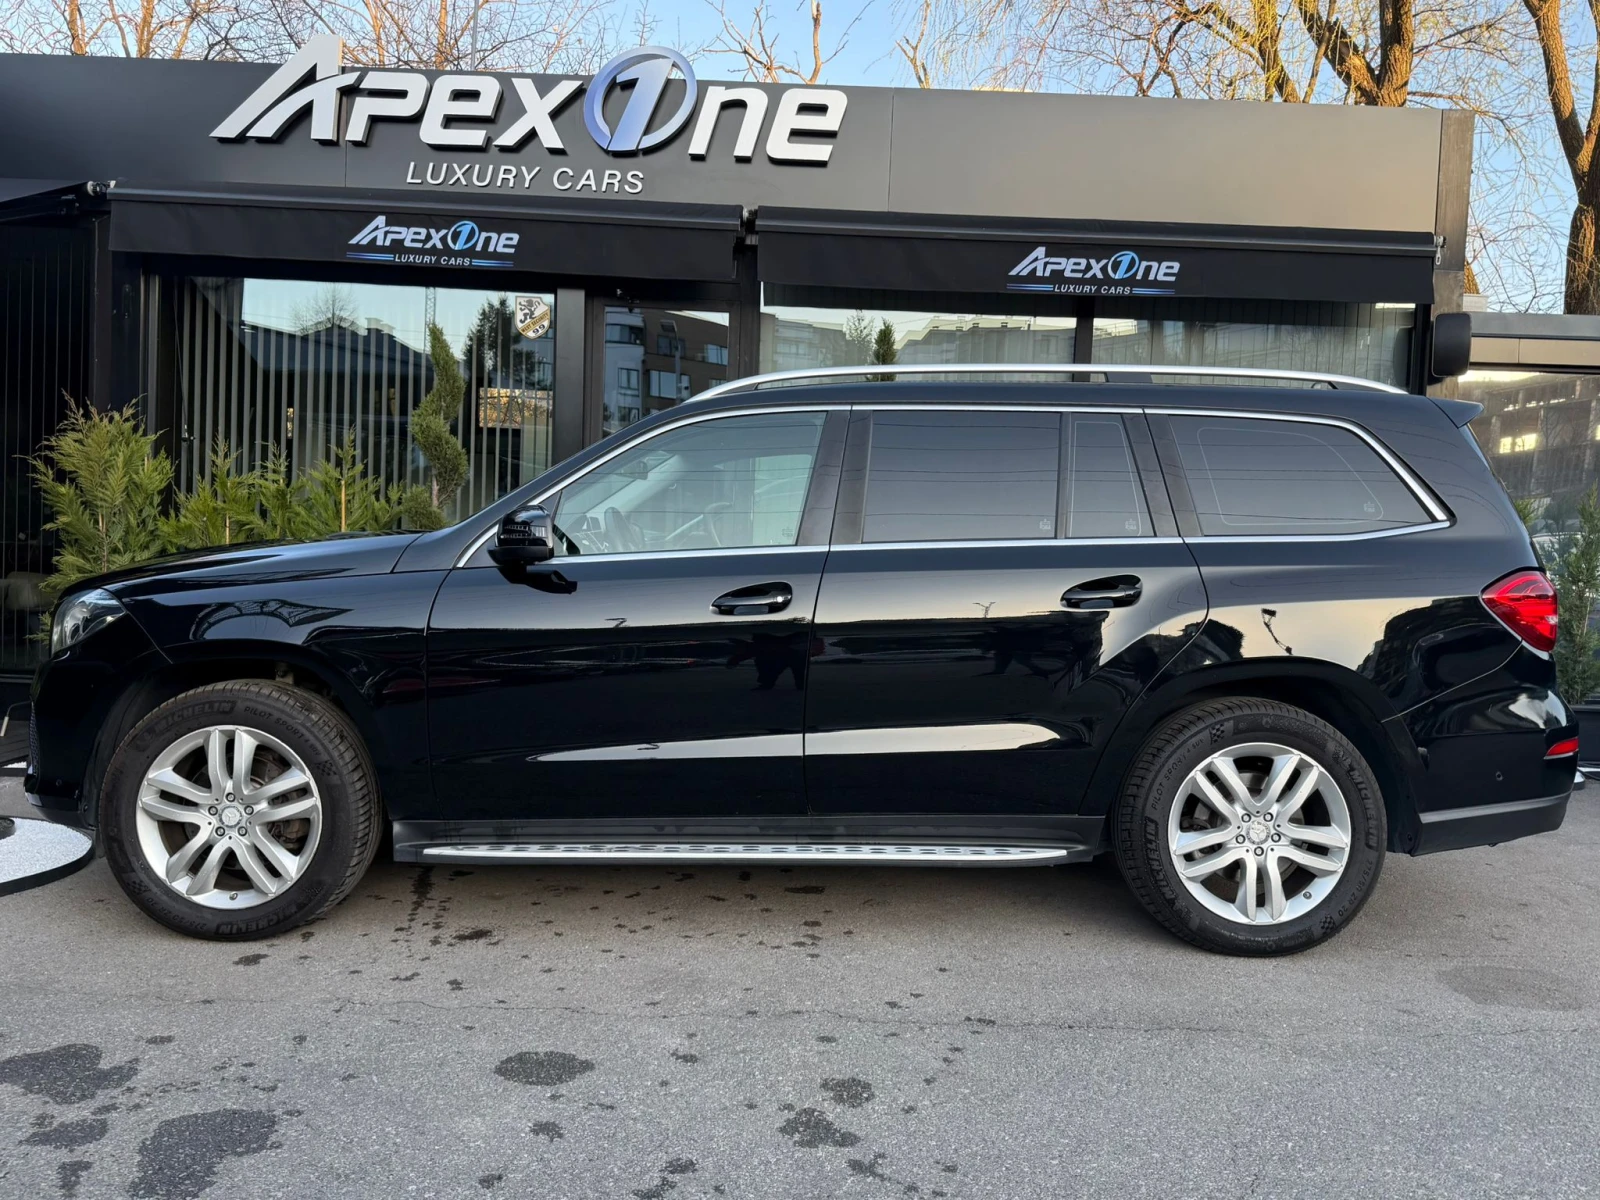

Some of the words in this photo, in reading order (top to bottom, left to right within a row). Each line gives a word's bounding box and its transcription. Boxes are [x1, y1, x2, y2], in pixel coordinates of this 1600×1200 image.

[407, 160, 540, 189] LUXURY
[552, 167, 644, 194] CARS
[395, 253, 437, 264] LUXURY
[440, 255, 470, 266] CARS
[1055, 284, 1097, 294] LUXURY
[1101, 286, 1131, 295] CARS
[154, 701, 233, 733] MICHELIN
[244, 706, 272, 721] PILOT
[274, 717, 304, 739] SPORT
[1151, 783, 1165, 810] PILOT
[1164, 755, 1187, 781] SPORT
[1350, 770, 1378, 849] MICHELIN
[1145, 819, 1177, 902] MICHELIN
[218, 903, 298, 936] MICHELIN
